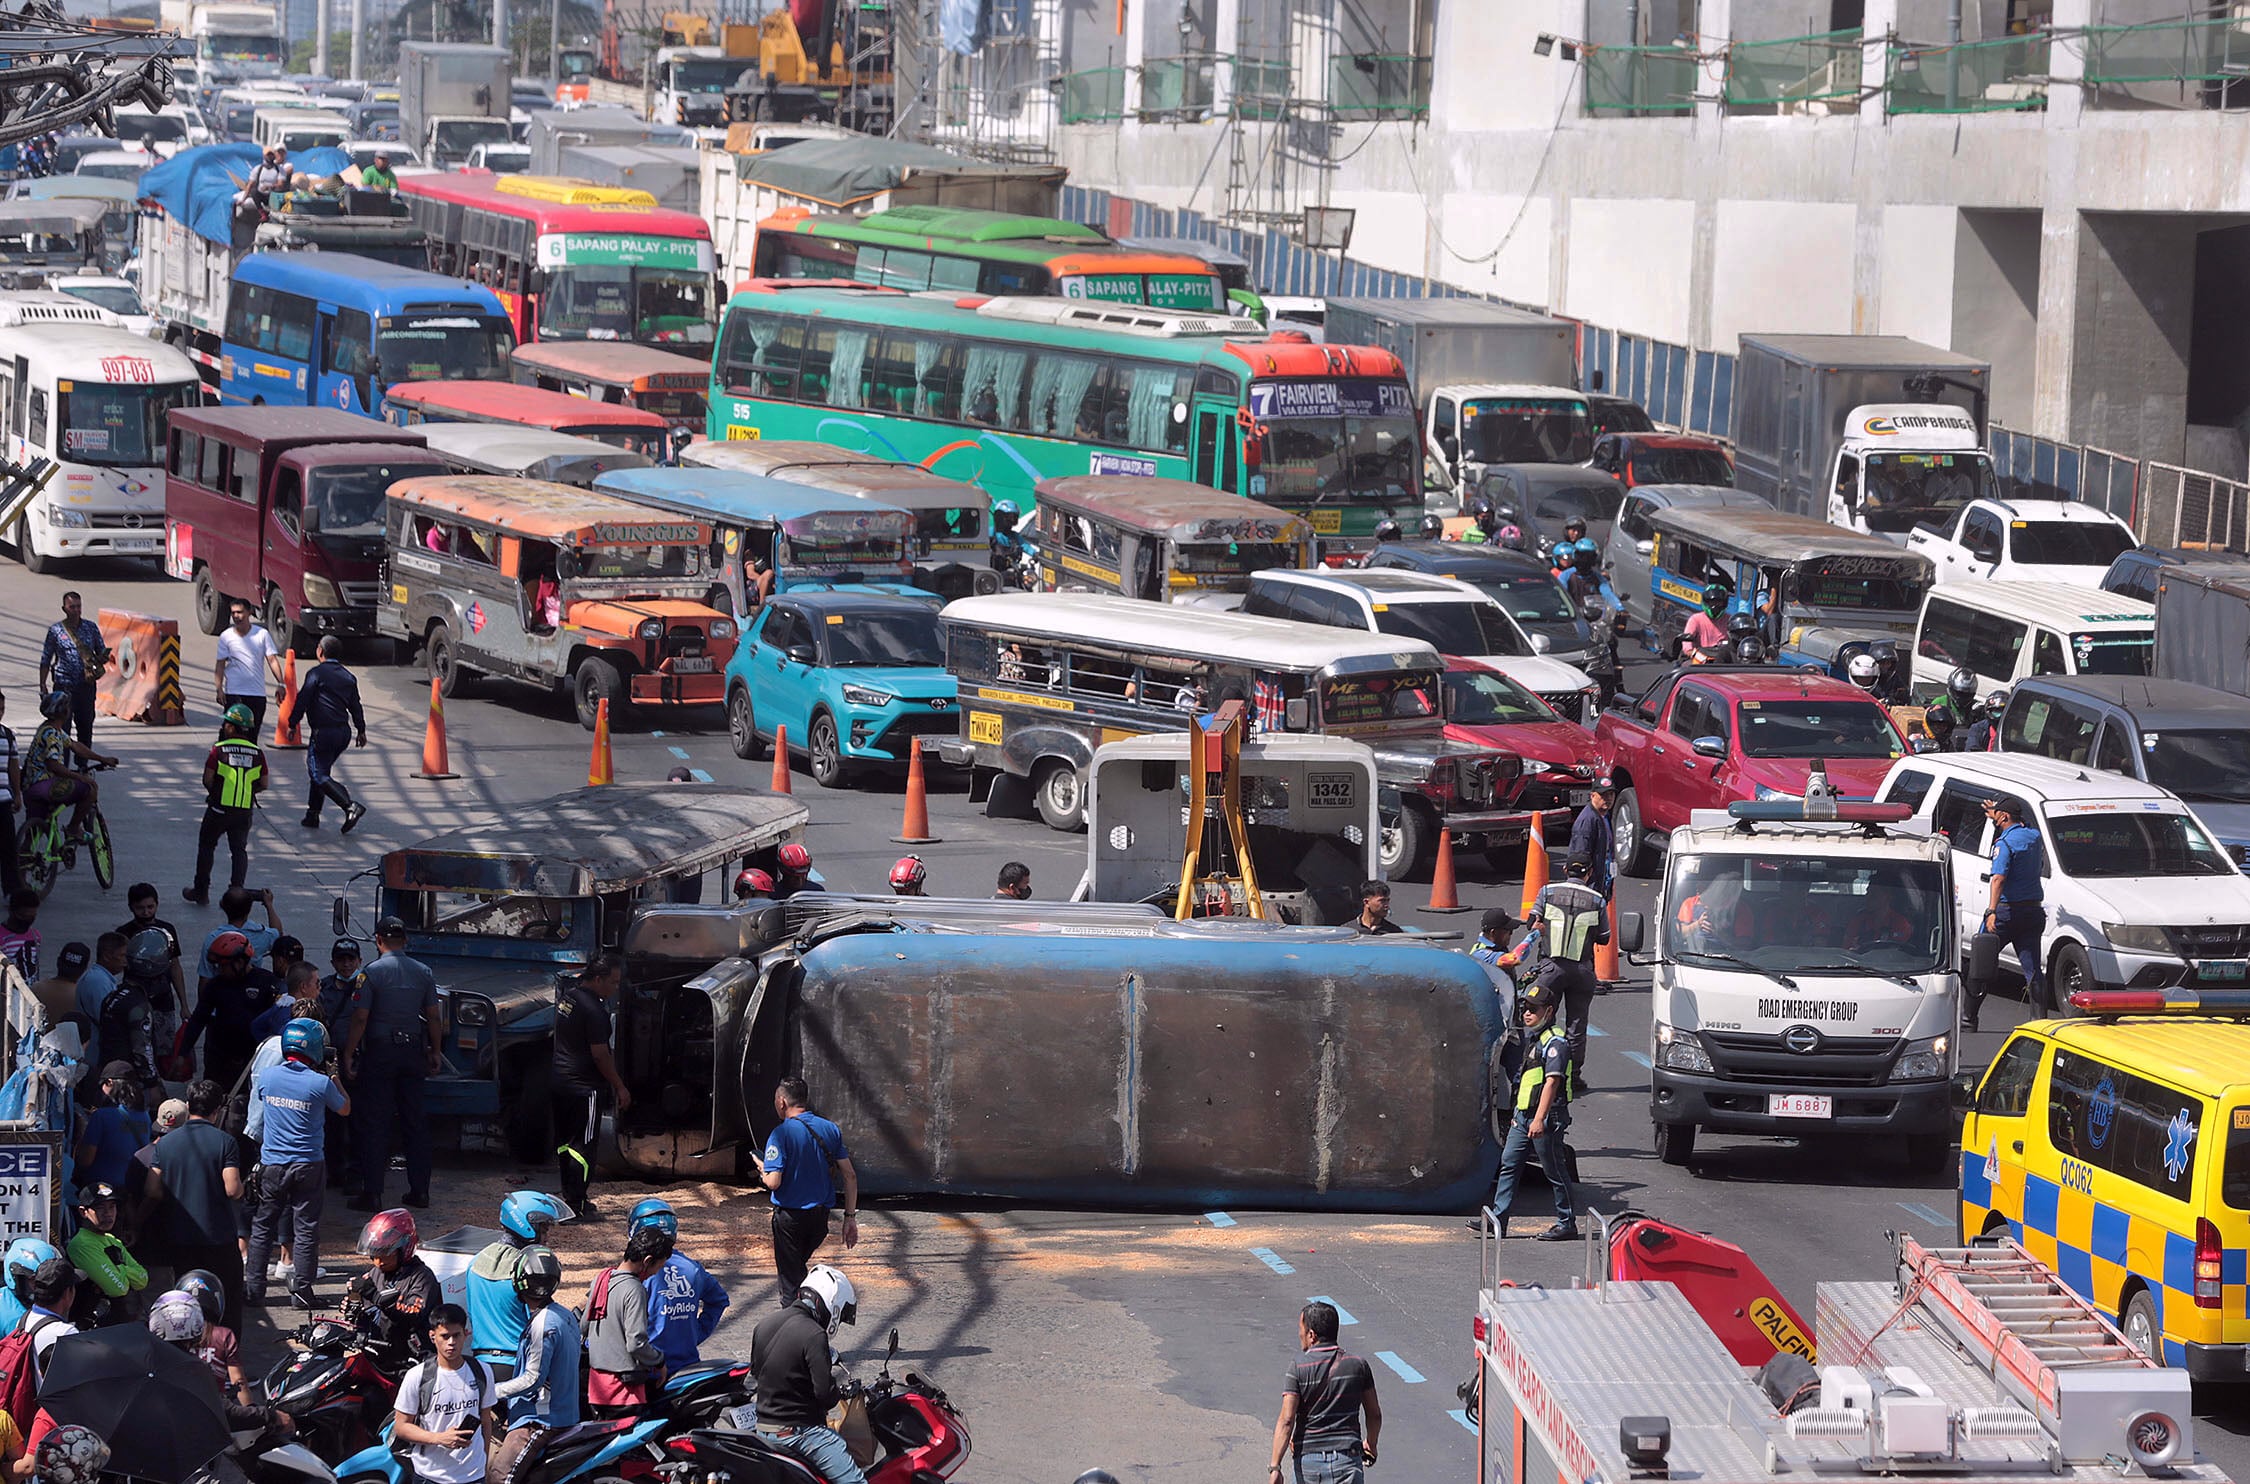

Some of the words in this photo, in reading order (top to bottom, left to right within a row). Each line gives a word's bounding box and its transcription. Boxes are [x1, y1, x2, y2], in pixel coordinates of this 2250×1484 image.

[550, 242, 561, 257] 6
[567, 239, 618, 252] SAPANG
[621, 240, 661, 254] PALAY
[670, 243, 697, 256] PITX
[1069, 283, 1081, 298] 6
[1087, 281, 1137, 295] SAPANG
[101, 360, 155, 383] 997-031
[1251, 385, 1273, 416] 7
[1279, 384, 1338, 405] FAIRVIEW
[1378, 385, 1413, 407] PITX
[1282, 406, 1299, 416] VIA
[1300, 406, 1319, 415] EAST
[1892, 416, 1976, 433] CAMPBRIDGE
[65, 432, 83, 448] SM
[1092, 455, 1101, 473] 7
[1328, 682, 1359, 696] ME
[1313, 783, 1350, 797] 1342
[1758, 999, 1779, 1018] ROAD
[1782, 1000, 1829, 1020] EMERGENCY
[1831, 1001, 1858, 1021] GROUP
[1705, 1021, 1742, 1030] HINO
[266, 1095, 312, 1111] PRESIDENT
[1774, 1100, 1788, 1110] JM
[1796, 1100, 1828, 1111] 6887
[2093, 1101, 2108, 1127] HB
[2060, 1157, 2093, 1195] QC062
[28, 1184, 40, 1196] 4
[4, 1221, 42, 1233] THE
[660, 1302, 696, 1316] JoyRide
[828, 1304, 841, 1335] EVO
[1493, 1315, 1516, 1381] URBAN
[1518, 1352, 1547, 1422] SEARCH
[1548, 1397, 1563, 1450] AND
[434, 1399, 479, 1413] Rakuten
